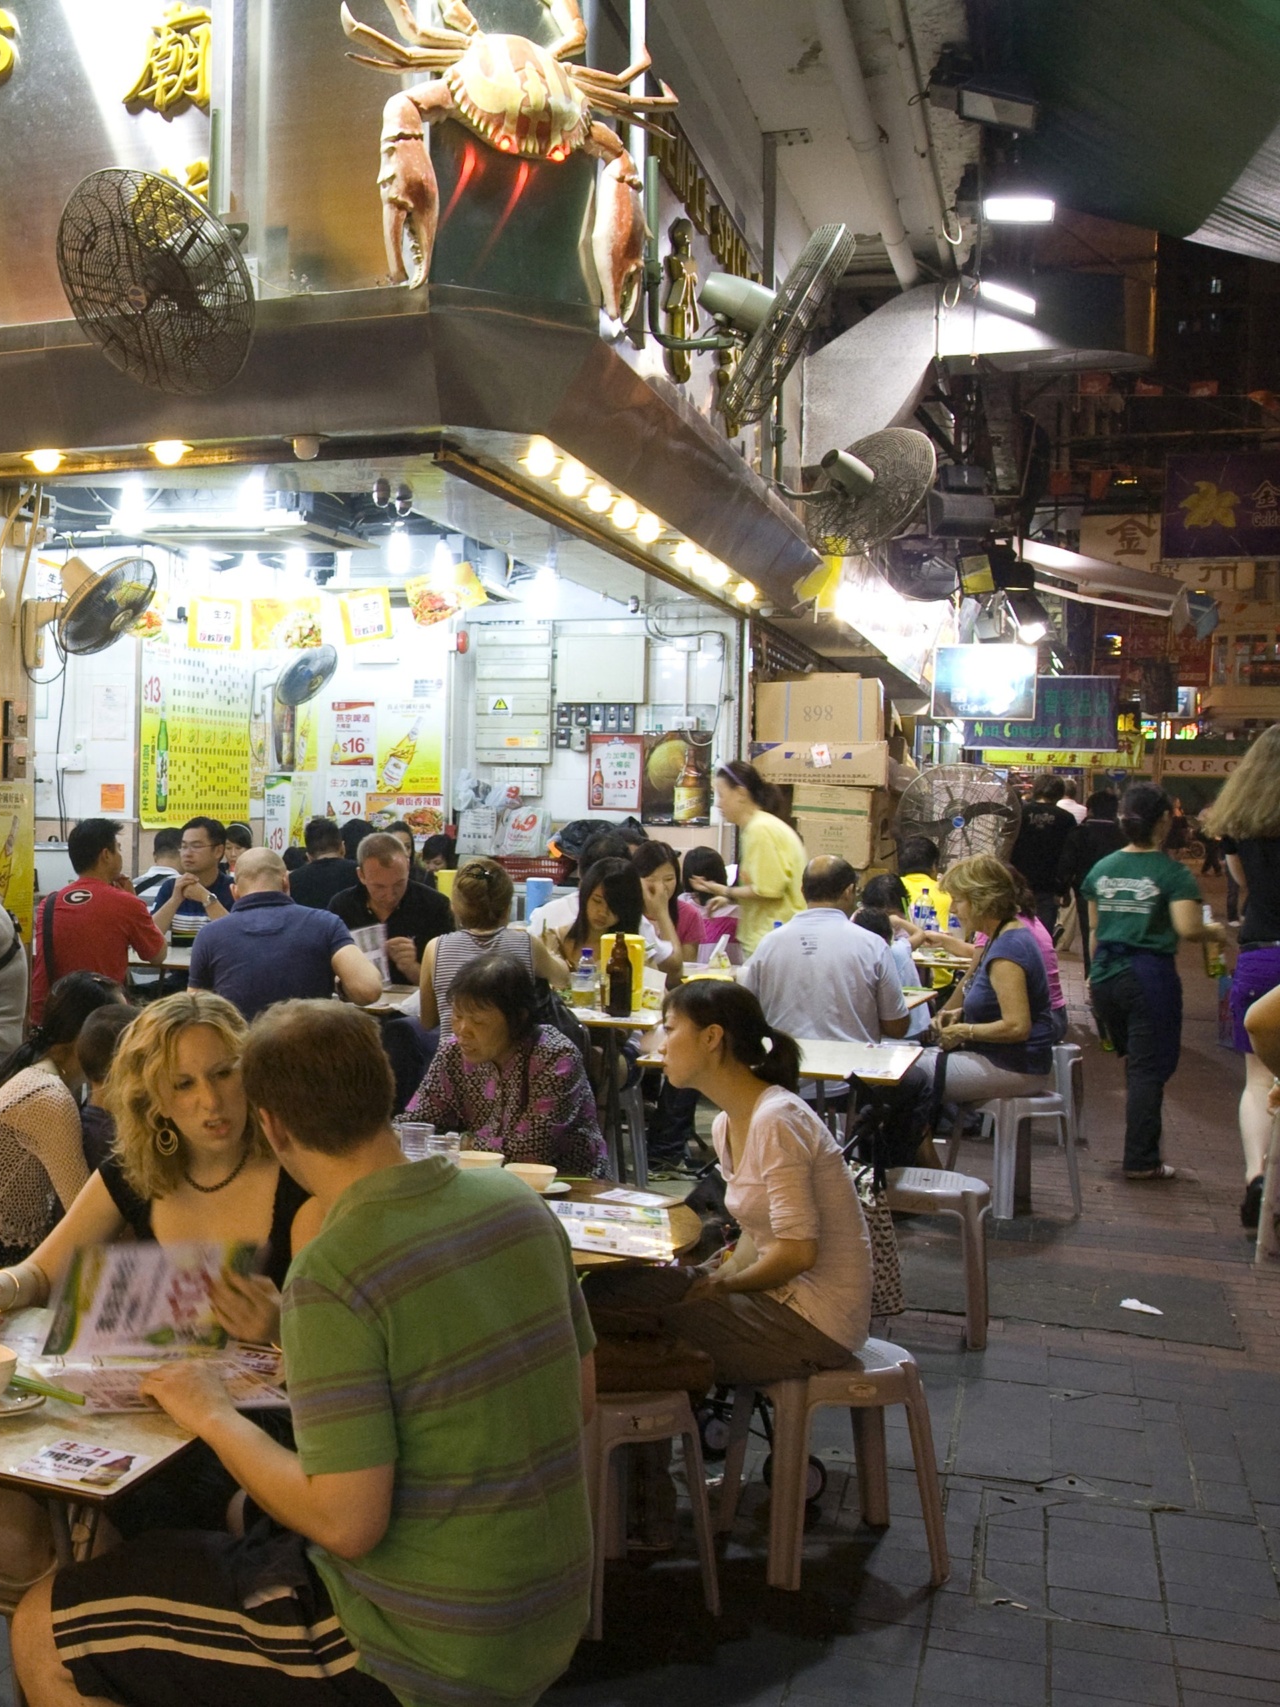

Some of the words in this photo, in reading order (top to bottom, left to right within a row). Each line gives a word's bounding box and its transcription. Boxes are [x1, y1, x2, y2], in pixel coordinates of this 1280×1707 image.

[1106, 518, 1158, 555] 金
[144, 676, 161, 703] $13
[336, 714, 370, 723] 燕京啤酒
[803, 705, 833, 722] 898
[342, 738, 365, 753] $16
[330, 779, 348, 787] 生力
[351, 779, 368, 787] 啤酒
[617, 779, 636, 789] $13
[270, 828, 283, 850] $13
[60, 1442, 111, 1457] 生力
[41, 1450, 96, 1467] 啤酒
